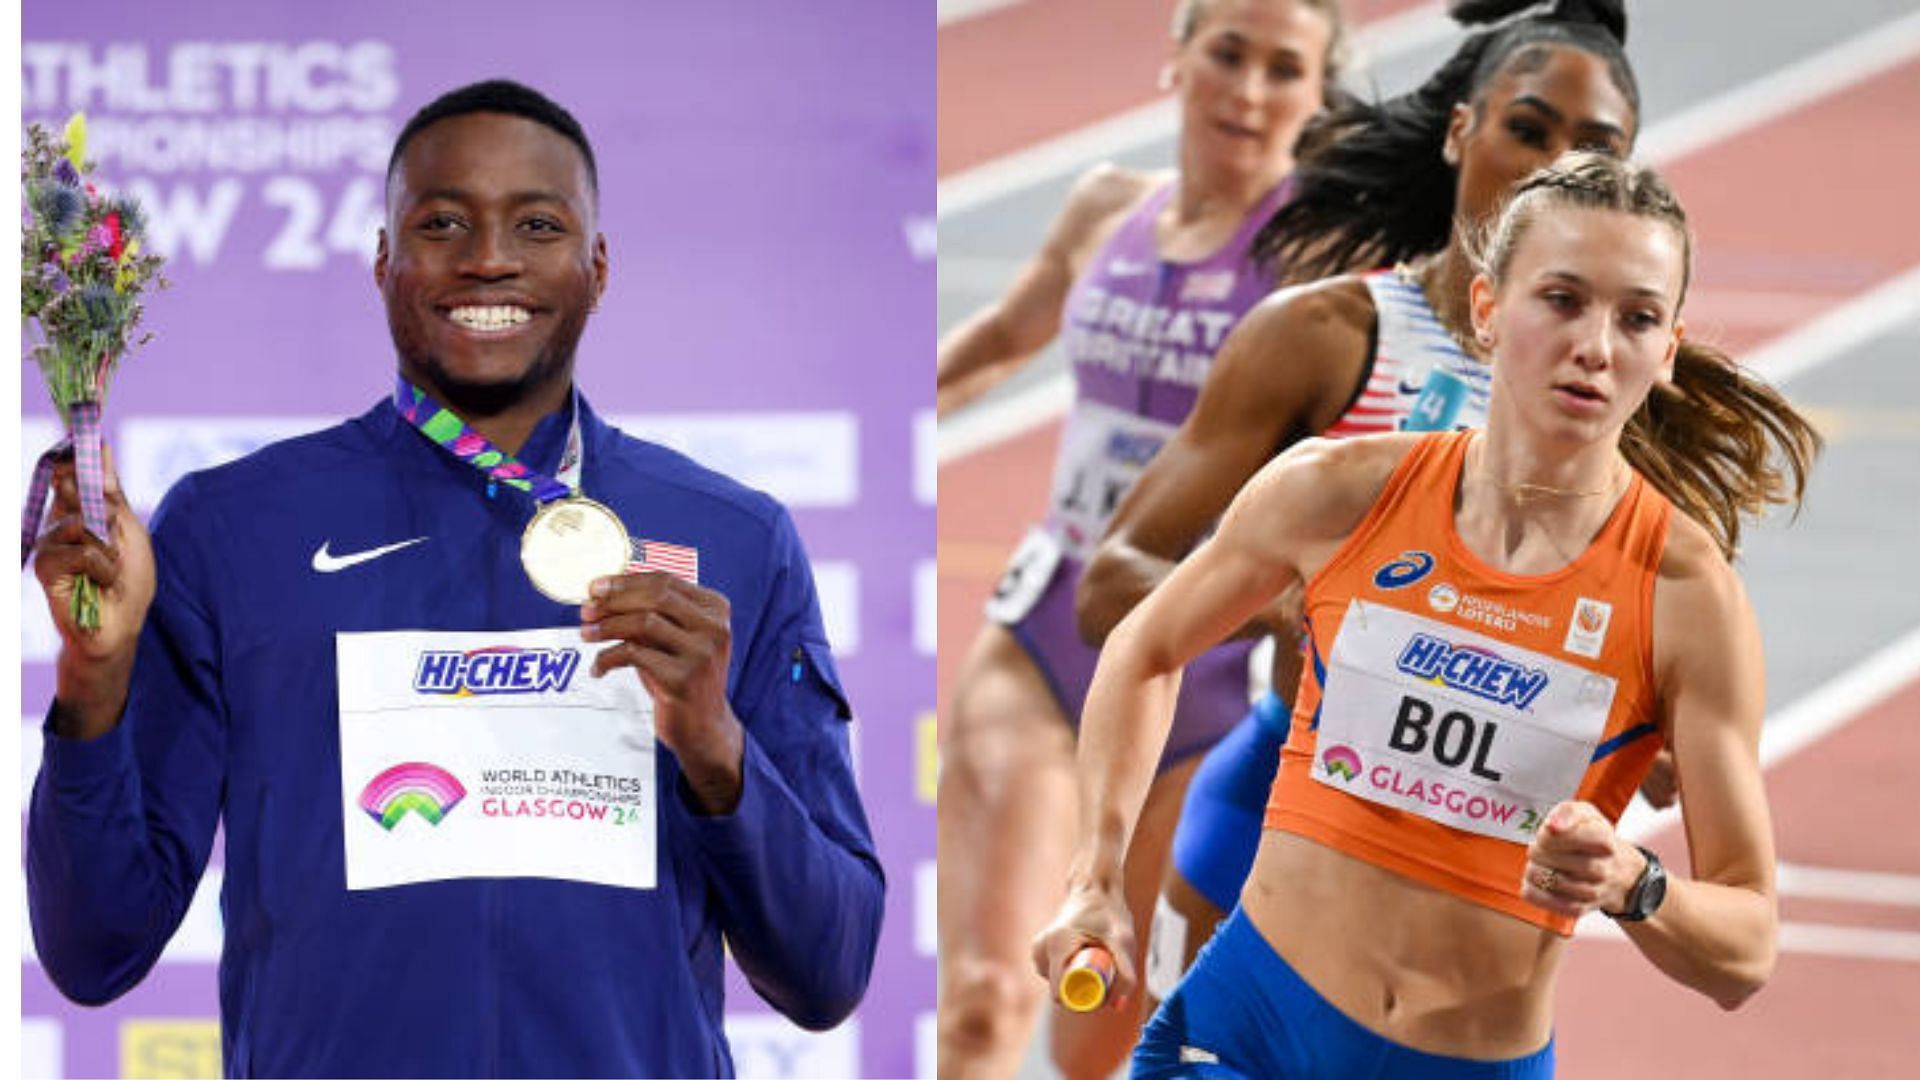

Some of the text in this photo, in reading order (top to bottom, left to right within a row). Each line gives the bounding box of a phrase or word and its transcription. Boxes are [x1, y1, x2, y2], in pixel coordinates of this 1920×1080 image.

[263, 178, 388, 270] 24
[1072, 290, 1234, 349] GREAT
[1421, 390, 1445, 424] 4
[415, 650, 577, 691] HI-CHEW
[1399, 634, 1547, 708] HI-CHEW
[1388, 695, 1502, 782] BOL
[482, 769, 641, 793] WORLD ATHLETICS
[482, 798, 609, 820] GLASGOW
[1369, 765, 1545, 832] GLASGOW 2
